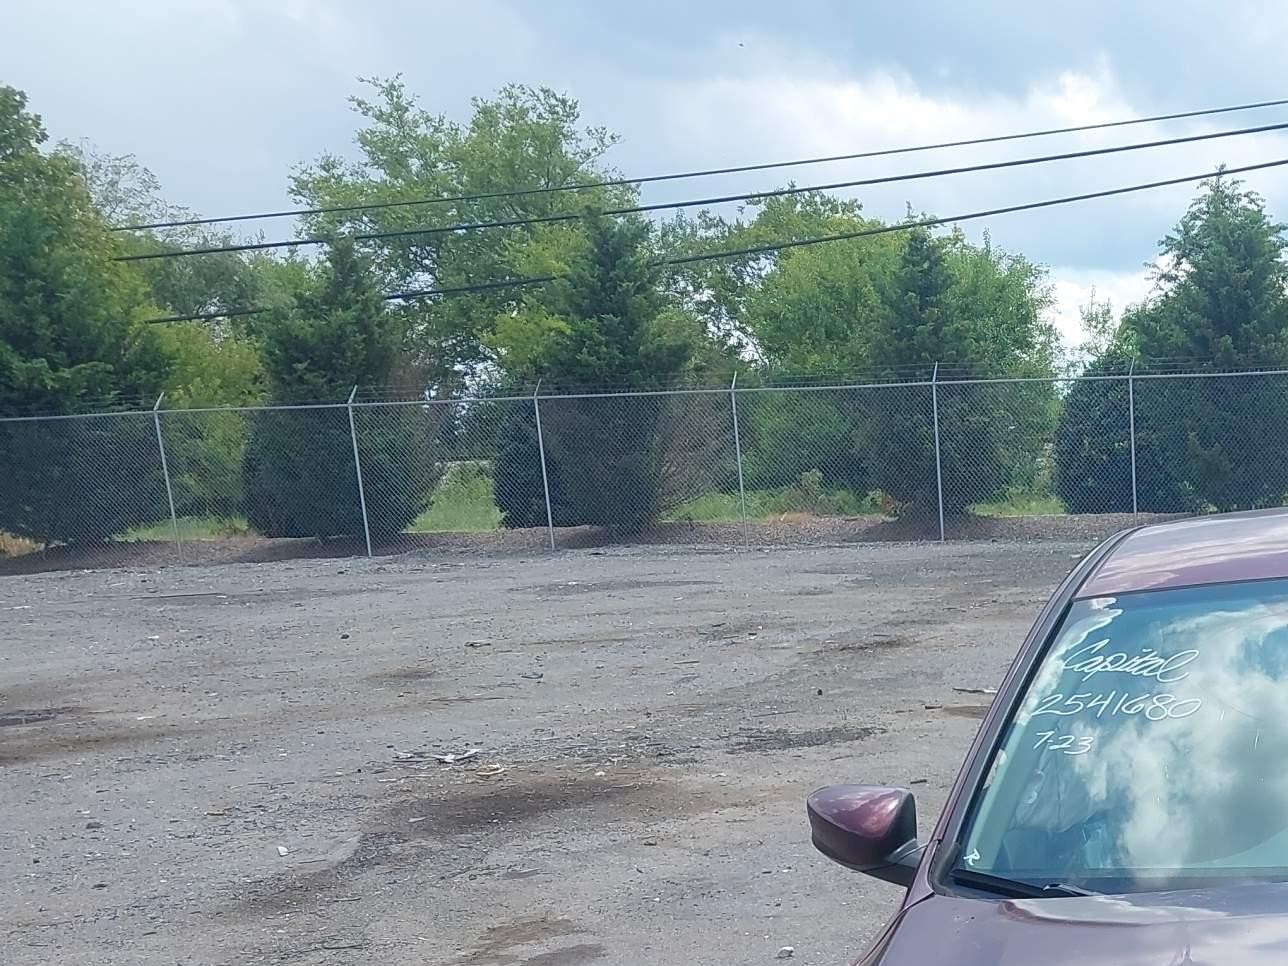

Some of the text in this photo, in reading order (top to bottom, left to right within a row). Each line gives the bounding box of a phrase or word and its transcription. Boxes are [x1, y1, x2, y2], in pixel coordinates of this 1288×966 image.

[1063, 638, 1199, 682] Capital
[1032, 690, 1201, 720] 2541680
[1033, 730, 1094, 755] 7-23
